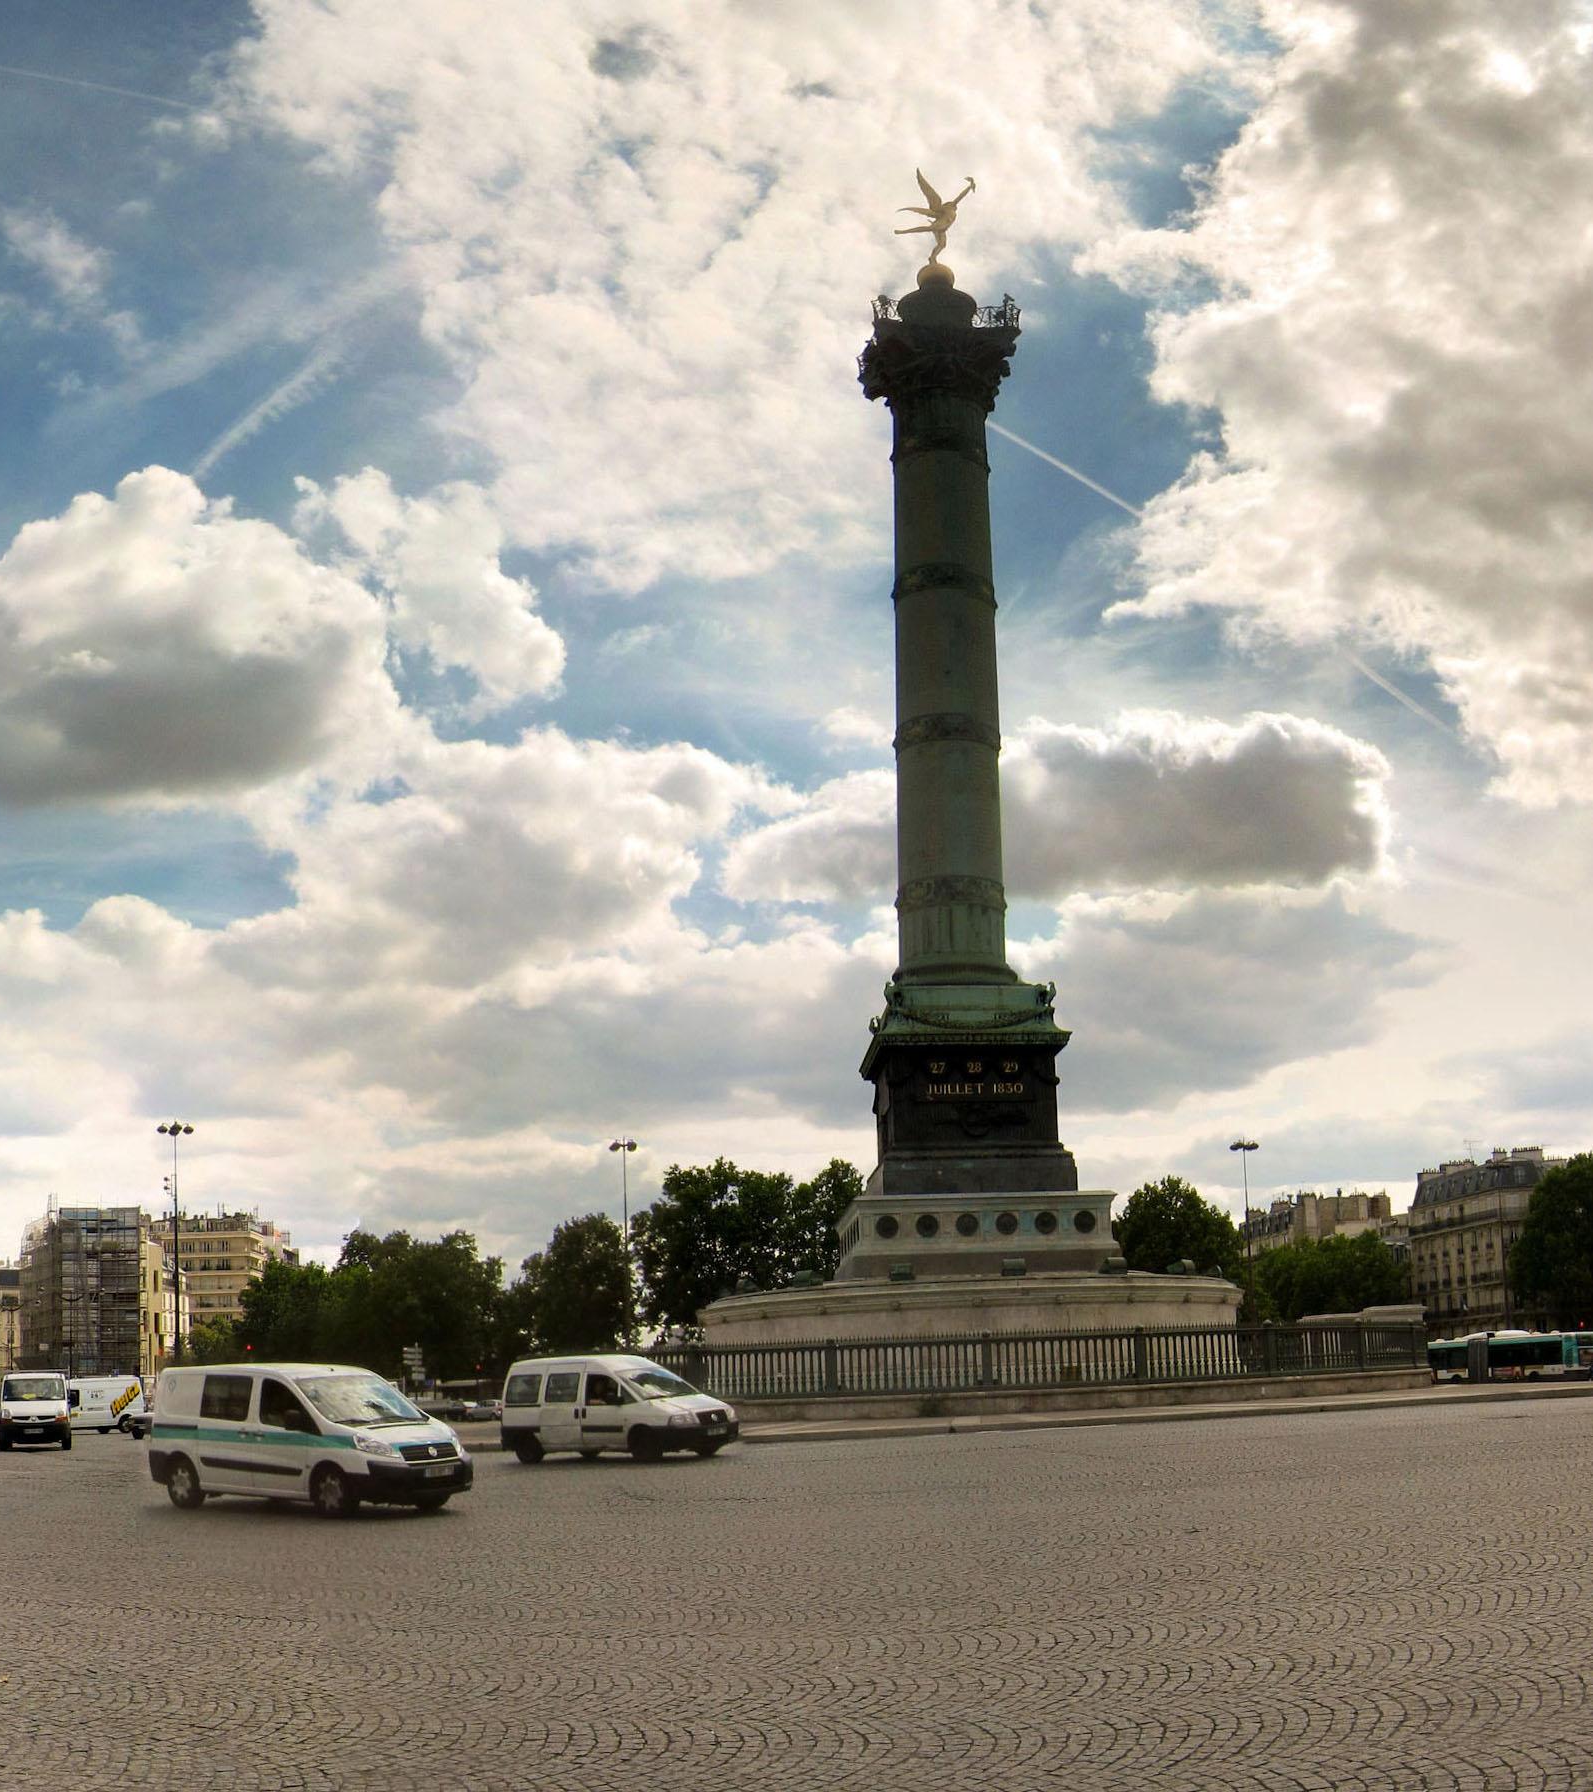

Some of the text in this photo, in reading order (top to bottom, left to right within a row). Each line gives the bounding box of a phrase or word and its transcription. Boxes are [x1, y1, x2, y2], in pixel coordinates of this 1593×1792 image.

[930, 1062, 1019, 1074] 27 28 29
[926, 1083, 1024, 1095] JUILLET 1830
[110, 1380, 141, 1418] Hertz
